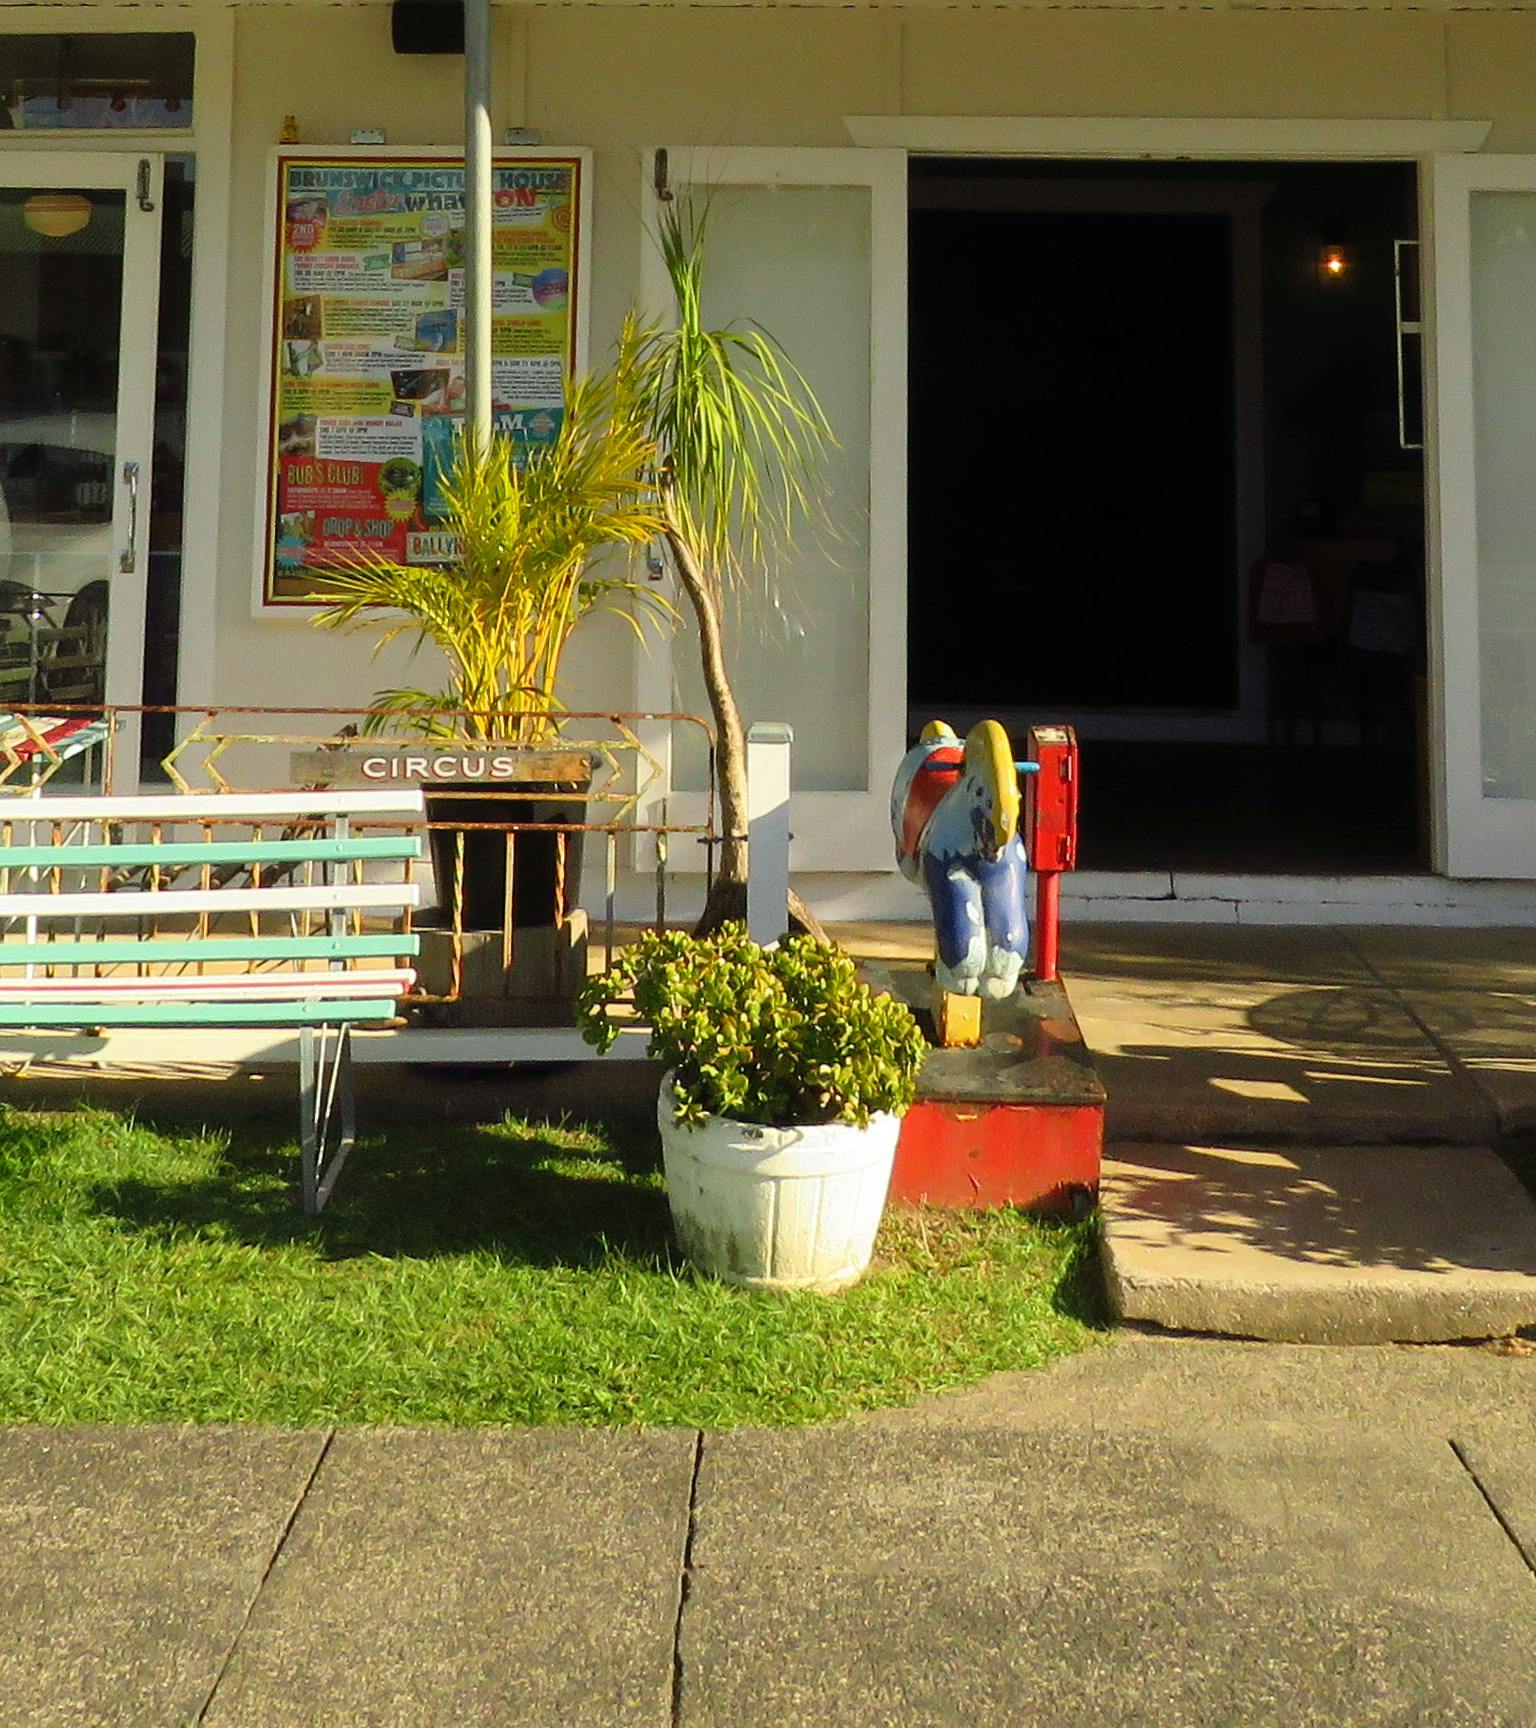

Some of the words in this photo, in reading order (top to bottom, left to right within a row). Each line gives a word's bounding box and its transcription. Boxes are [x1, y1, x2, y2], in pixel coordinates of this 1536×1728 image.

[289, 170, 405, 188] BRUNSWICK
[500, 172, 570, 189] HOUSE
[495, 188, 537, 208] ON
[363, 756, 514, 779] CIRCUS
